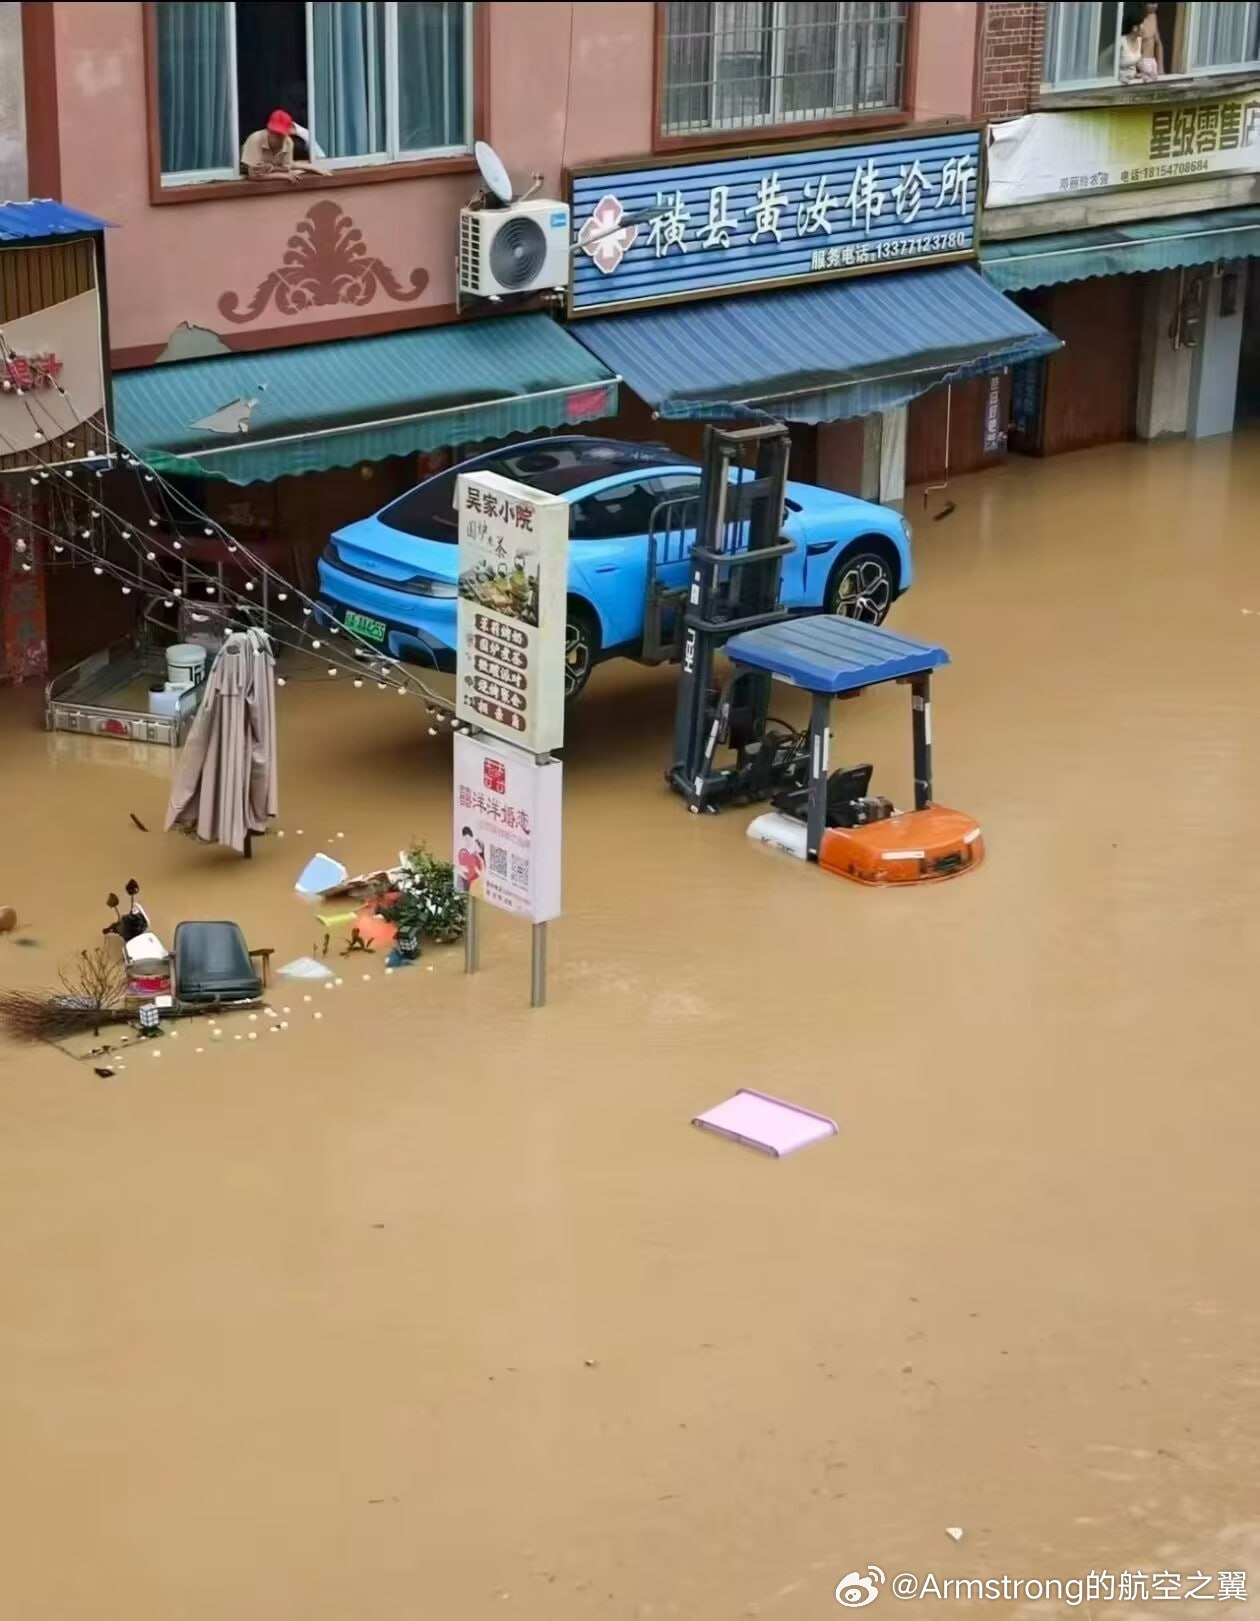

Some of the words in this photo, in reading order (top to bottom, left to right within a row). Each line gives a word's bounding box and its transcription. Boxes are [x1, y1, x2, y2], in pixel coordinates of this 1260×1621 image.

[646, 154, 976, 257] 横县黄汝伟诊所
[466, 486, 534, 532] 吴家小院
